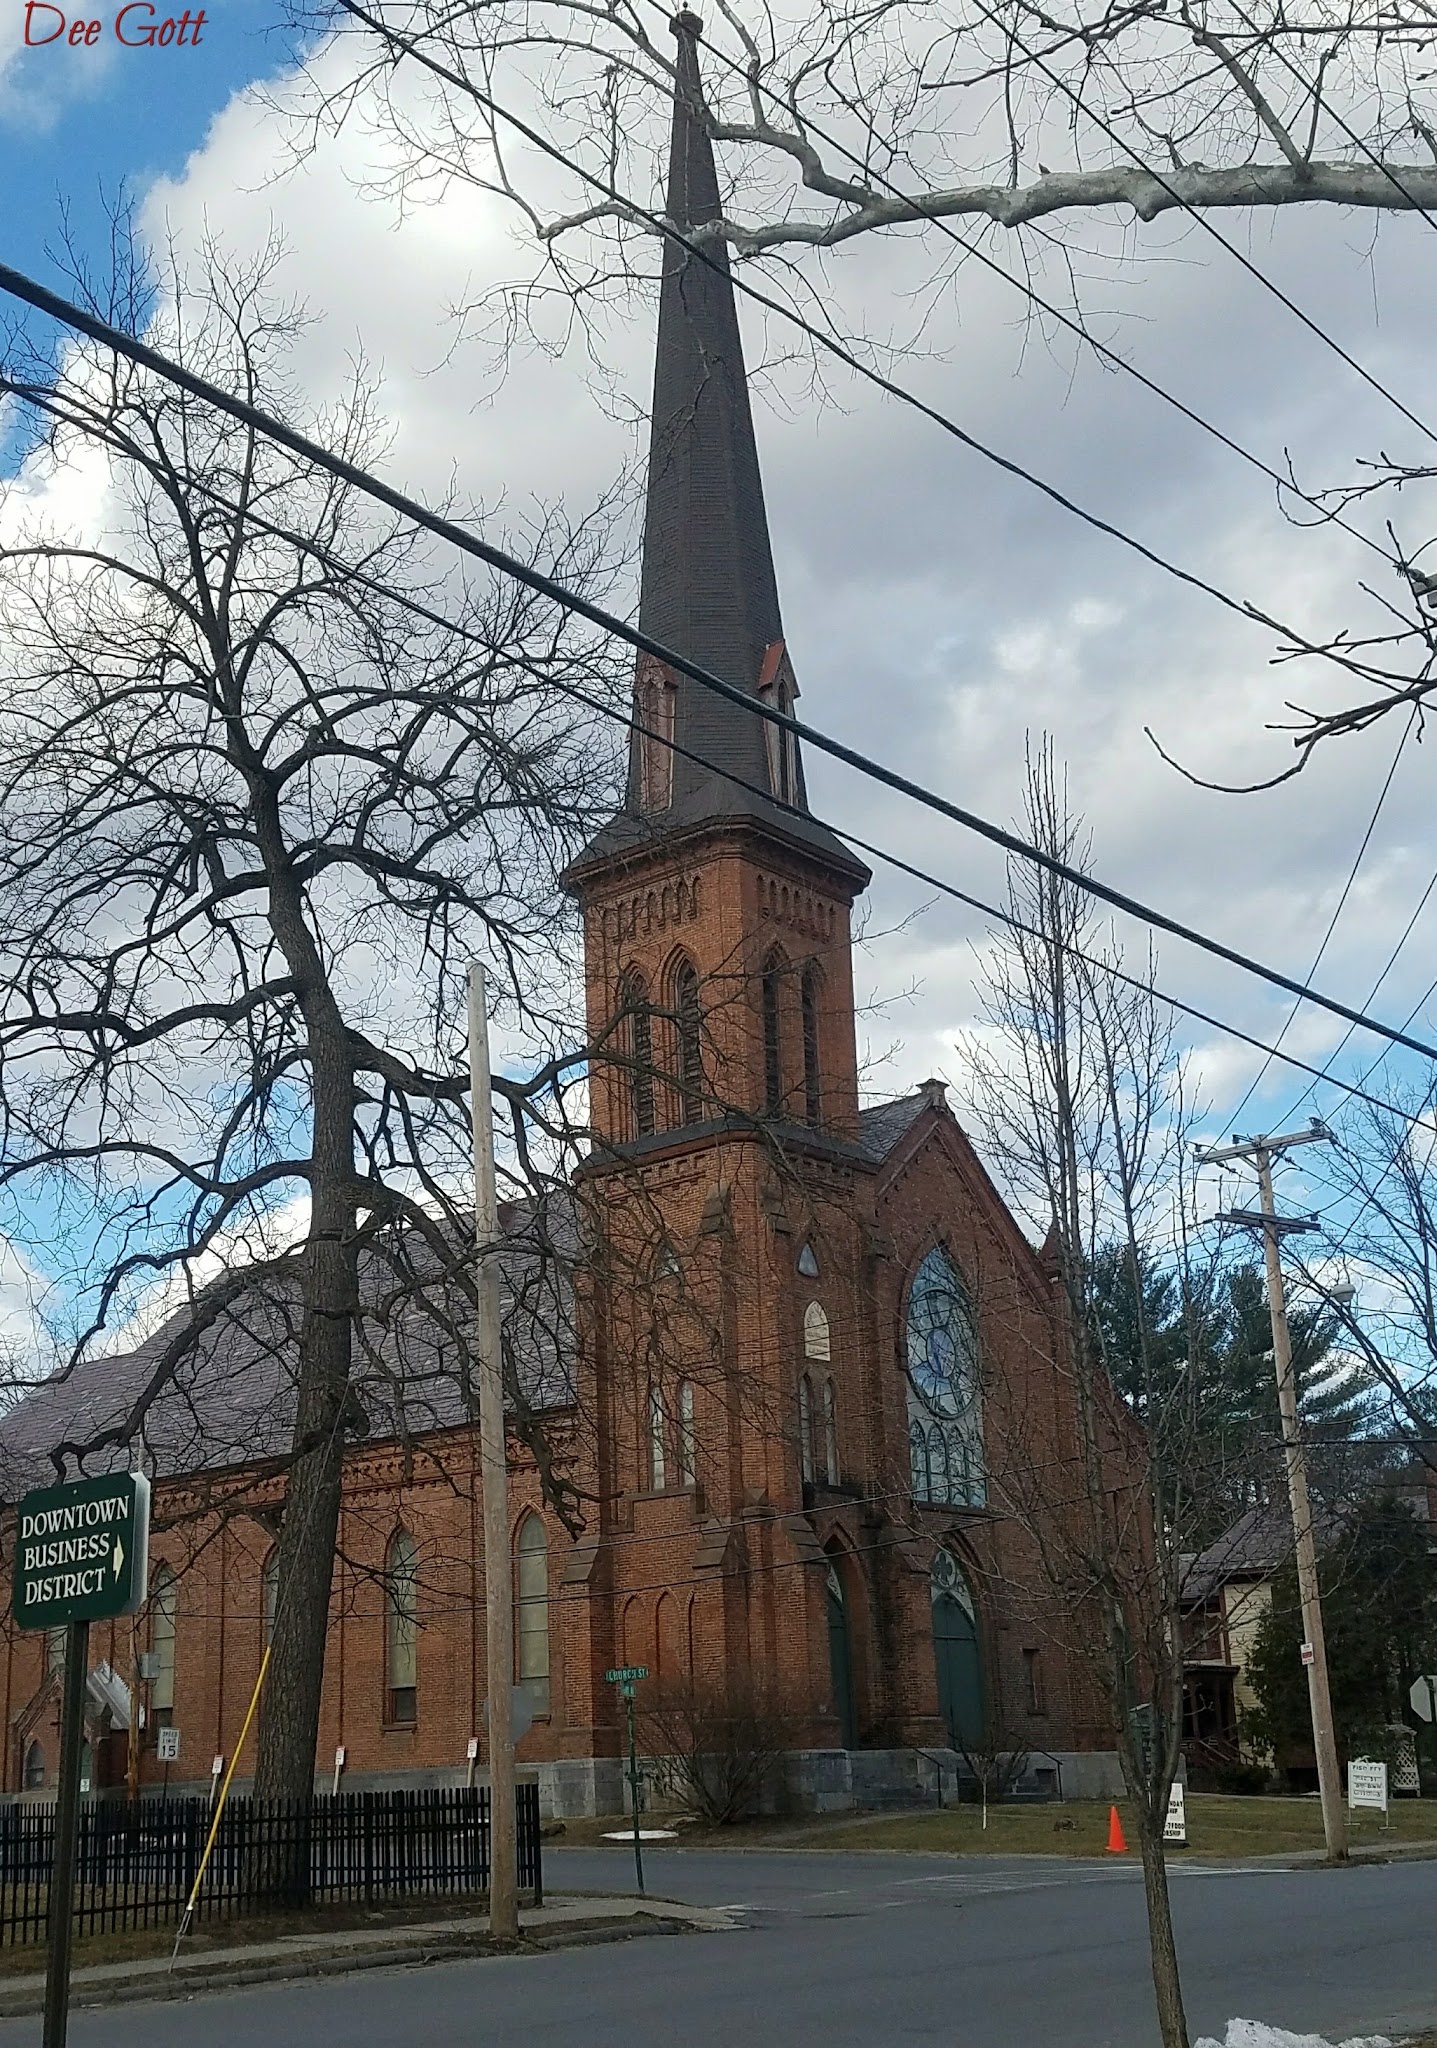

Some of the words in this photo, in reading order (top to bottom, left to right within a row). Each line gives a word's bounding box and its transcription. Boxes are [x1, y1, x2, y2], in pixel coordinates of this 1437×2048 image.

[21, 1495, 130, 1539] DOWNTOWN
[23, 1532, 110, 1571] BUSINESS
[24, 1566, 106, 1605] DISTRICT
[608, 1669, 637, 1680] CHURCH
[638, 1668, 646, 1678] ST
[162, 1745, 176, 1757] 15
